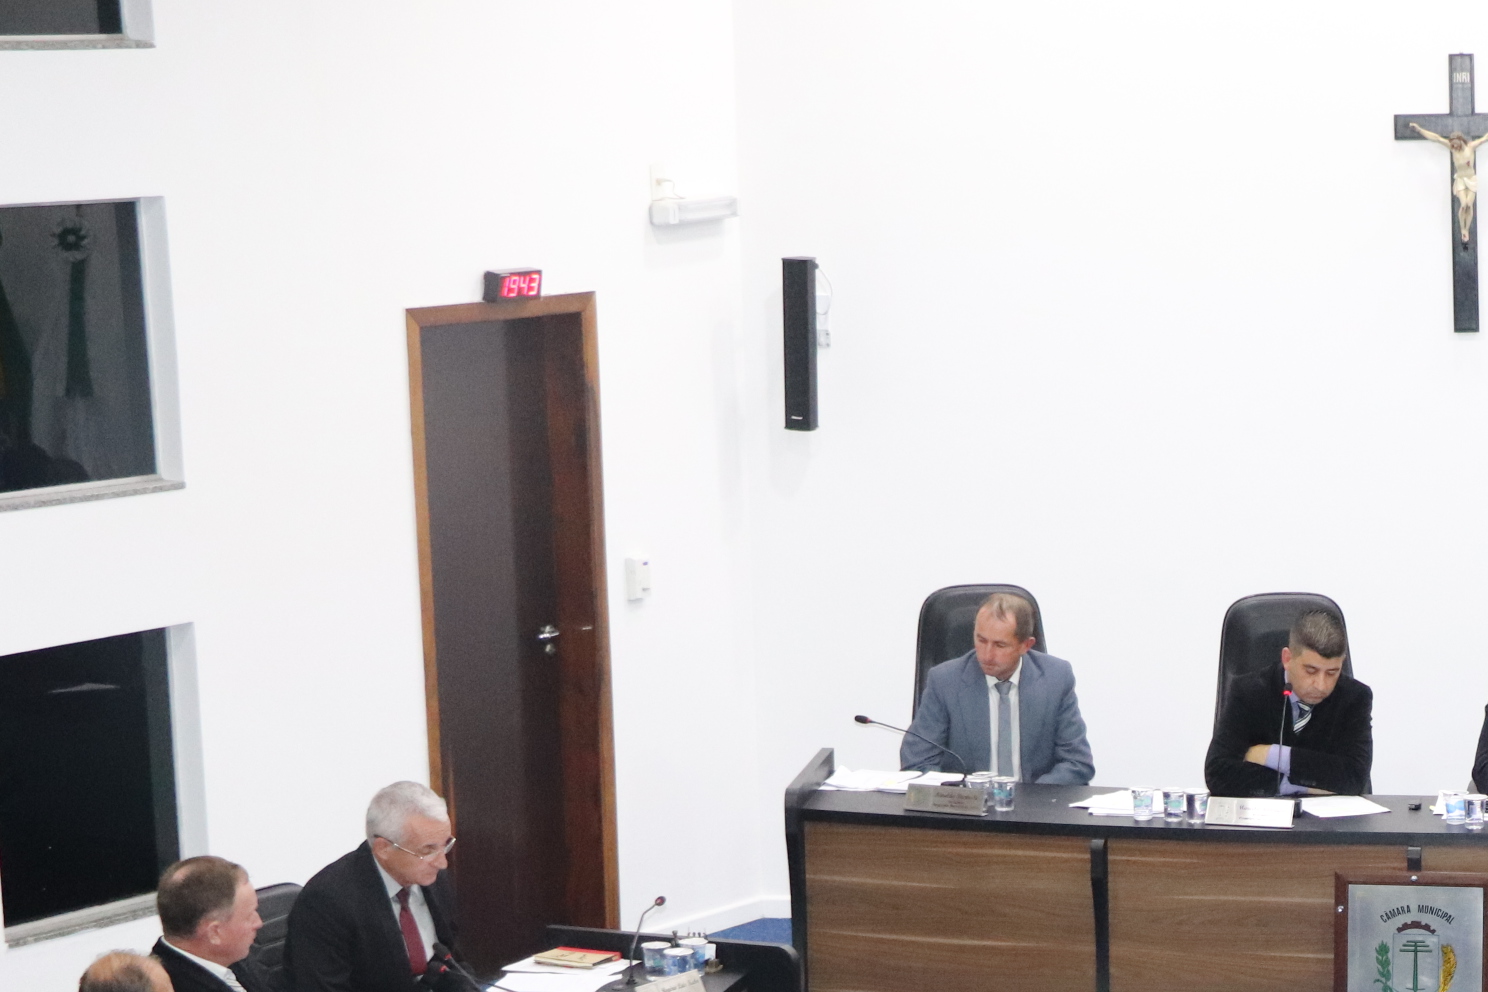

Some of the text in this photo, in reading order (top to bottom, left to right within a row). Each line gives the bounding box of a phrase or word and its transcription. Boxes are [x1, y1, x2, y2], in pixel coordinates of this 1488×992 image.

[1453, 72, 1470, 83] INRI
[503, 273, 540, 298] 1943
[1417, 904, 1456, 925] MUNICIPAL
